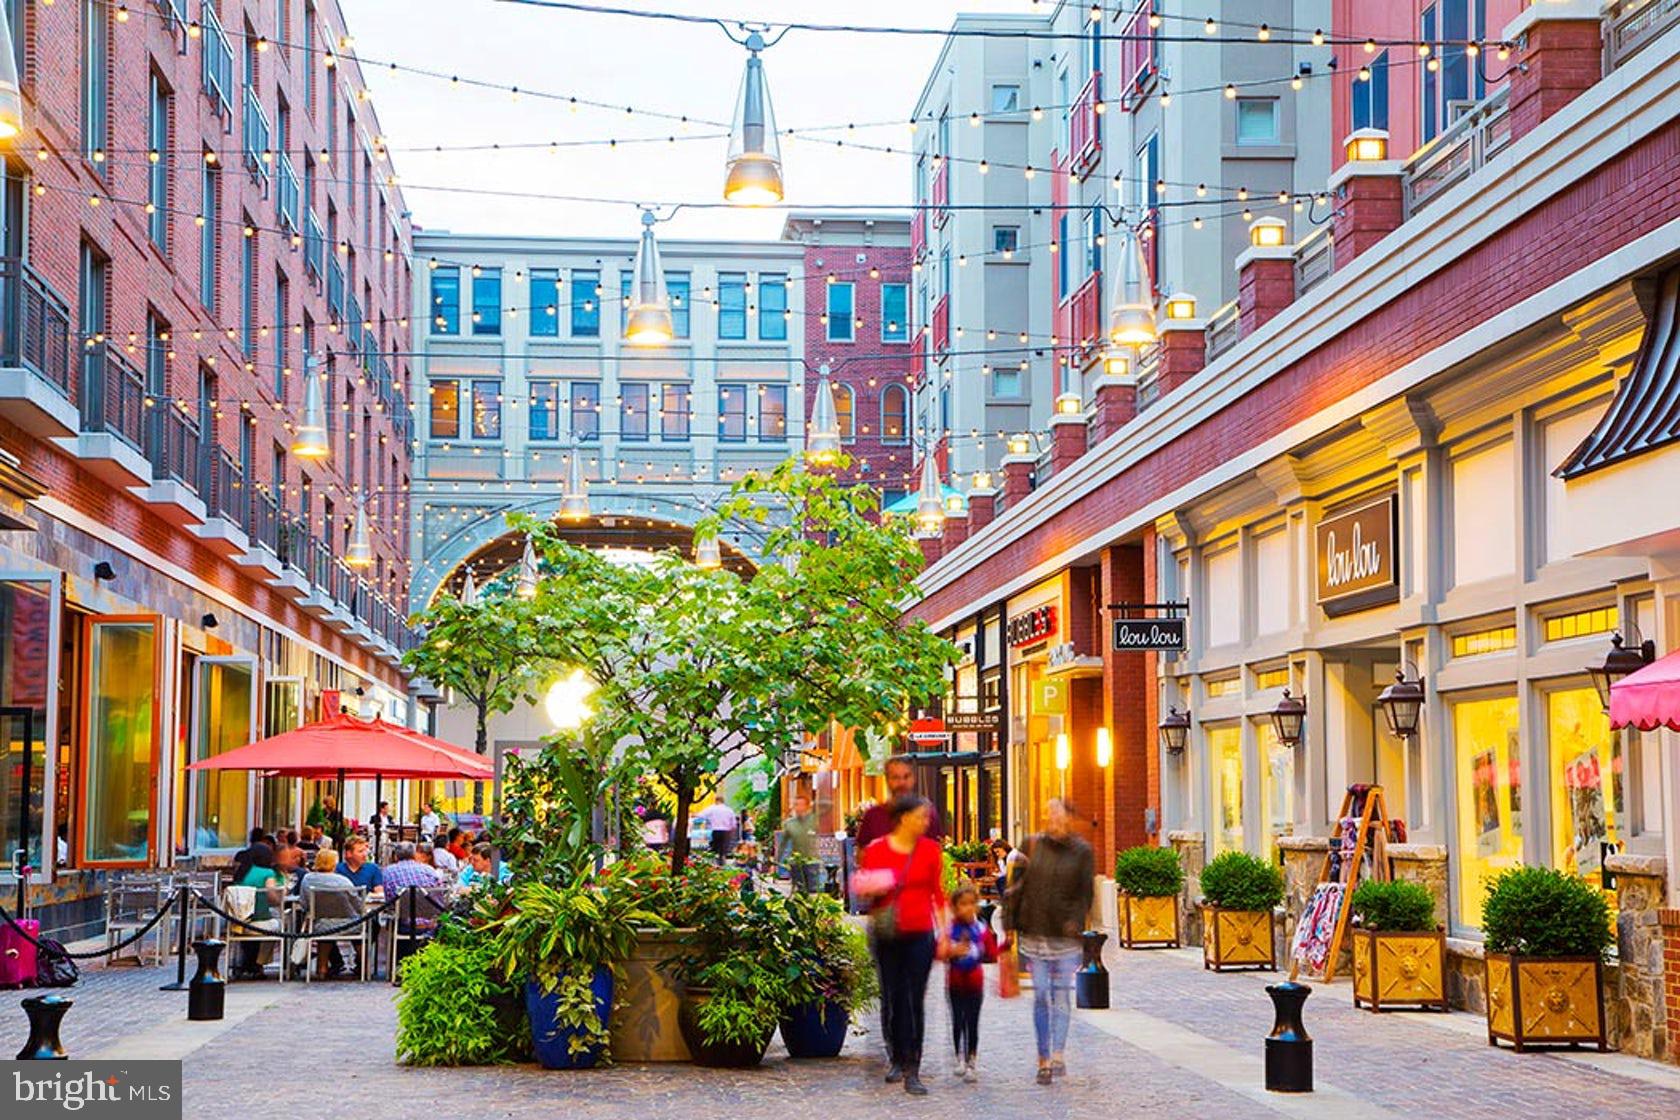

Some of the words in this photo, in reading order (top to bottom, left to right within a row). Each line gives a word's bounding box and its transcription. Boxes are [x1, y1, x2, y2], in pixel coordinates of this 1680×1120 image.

[1326, 530, 1353, 587] lou
[1353, 521, 1380, 579] lou
[1119, 624, 1149, 645] lou
[1150, 624, 1181, 645] lou
[1043, 685, 1058, 708] P
